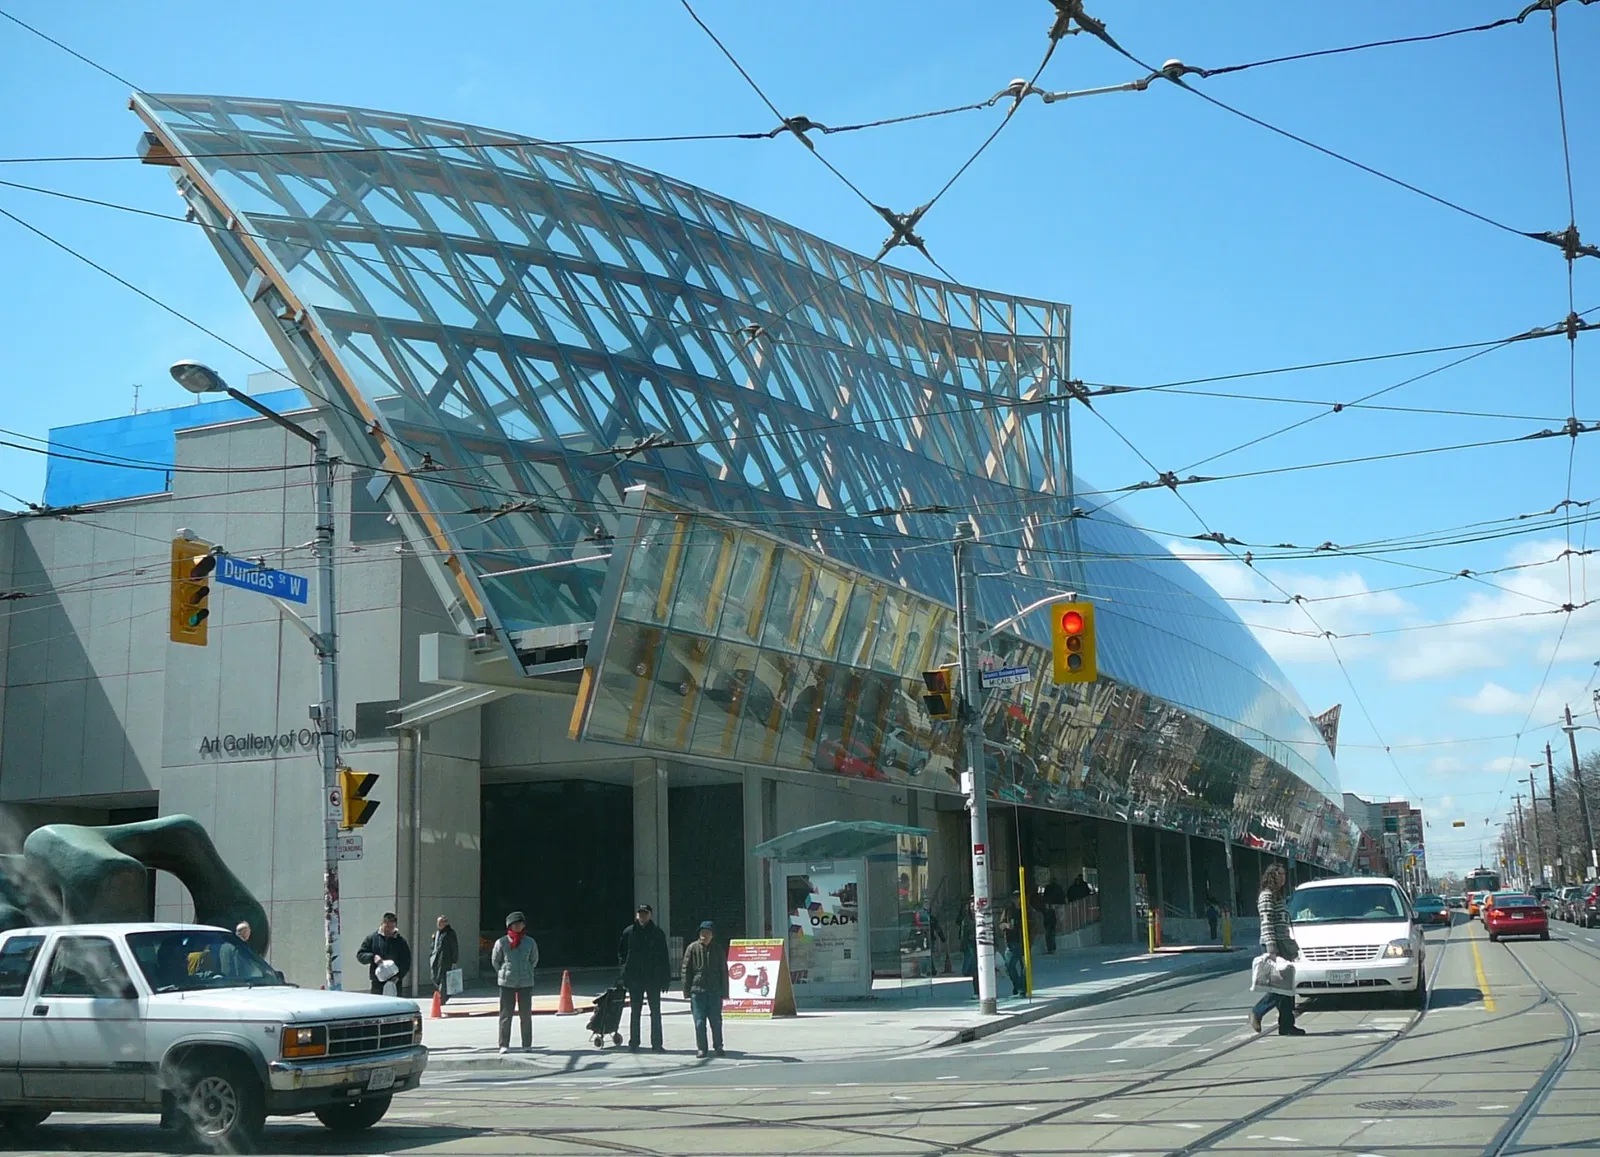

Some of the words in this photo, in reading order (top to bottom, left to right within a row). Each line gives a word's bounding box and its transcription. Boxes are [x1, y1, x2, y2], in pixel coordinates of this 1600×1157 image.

[224, 559, 274, 590] Dundas
[279, 574, 287, 585] St
[290, 577, 301, 597] W
[199, 735, 220, 754] Art
[223, 732, 277, 754] Gallery
[279, 730, 296, 748] of
[298, 725, 355, 746] Onio
